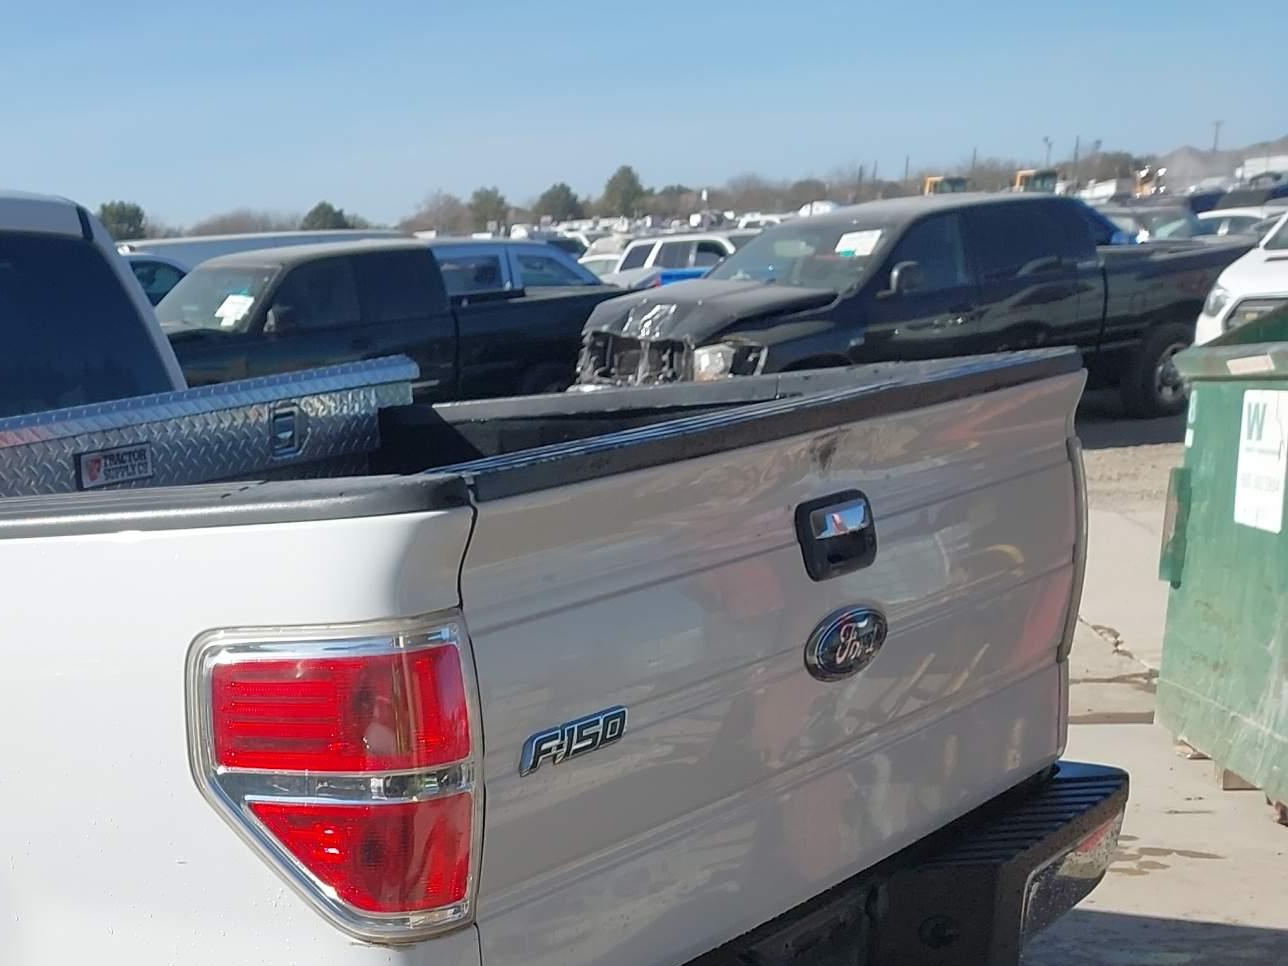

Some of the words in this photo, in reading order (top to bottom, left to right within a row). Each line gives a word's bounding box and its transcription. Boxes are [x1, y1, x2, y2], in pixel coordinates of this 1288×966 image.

[103, 448, 147, 466] TRACTOR
[103, 464, 136, 481] SUPPLY
[519, 705, 629, 778] F-150
